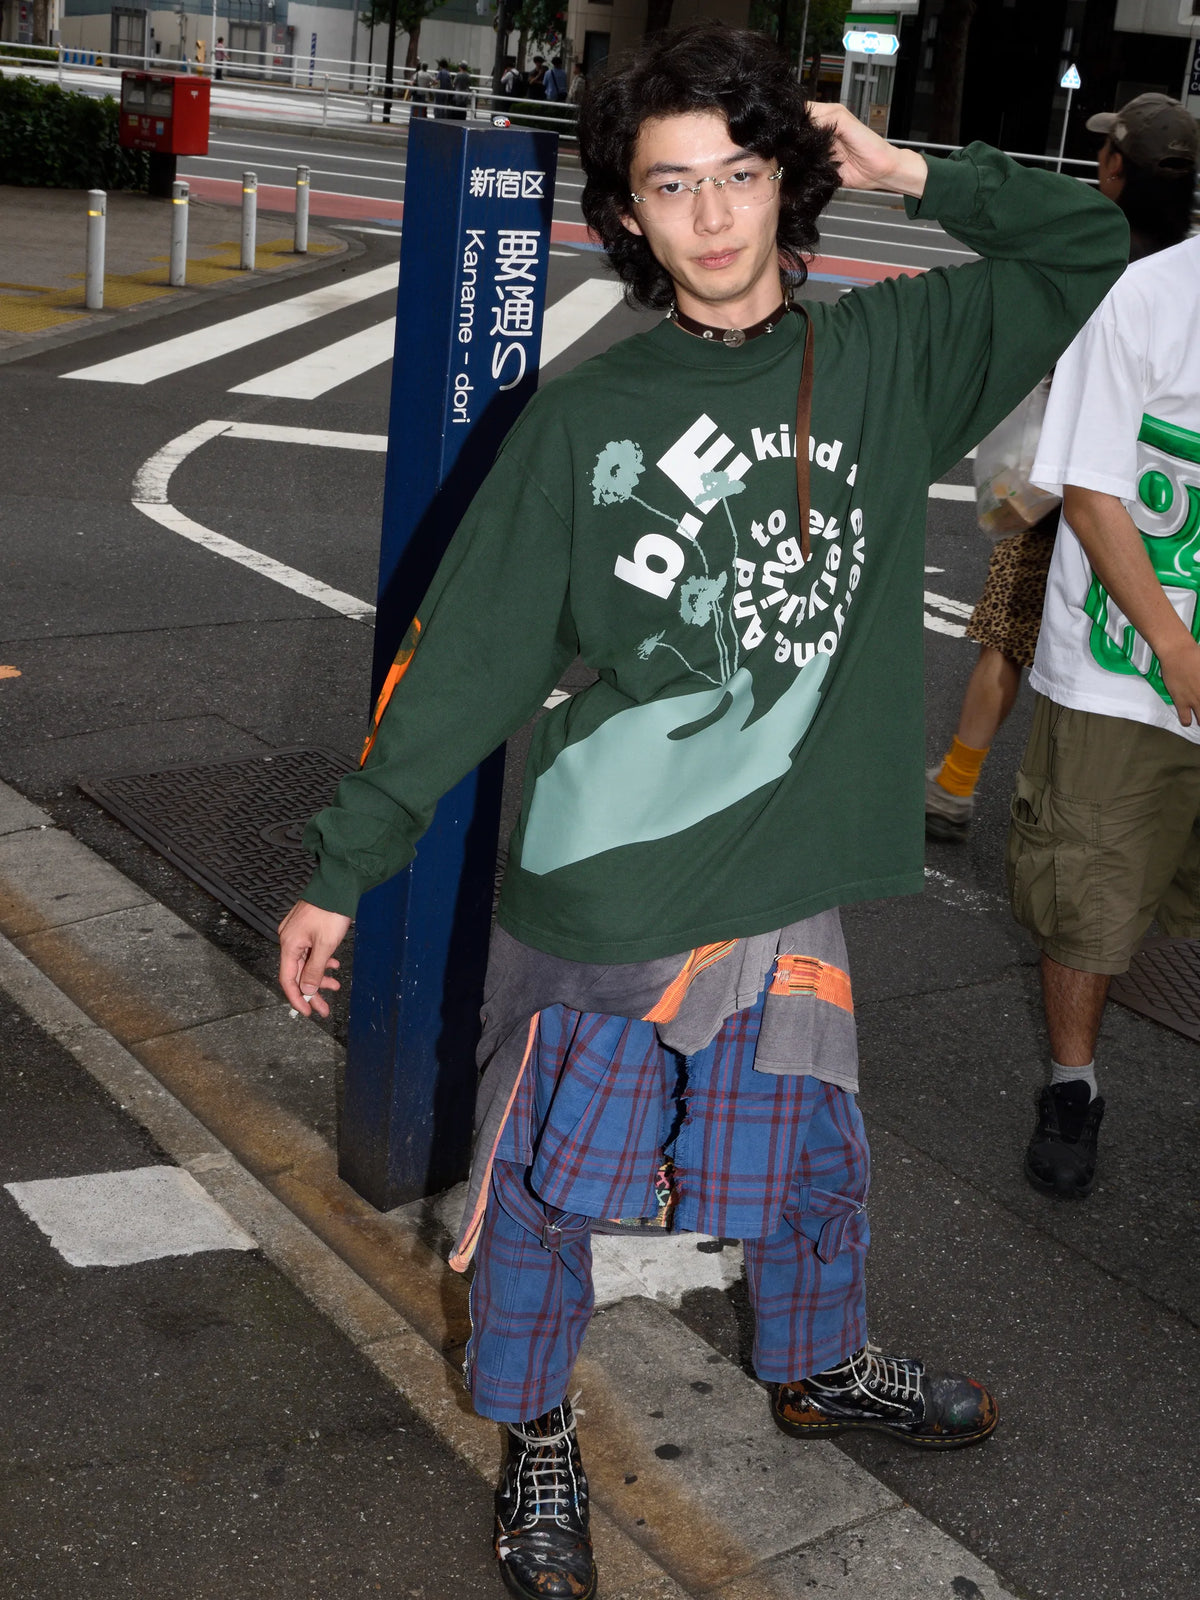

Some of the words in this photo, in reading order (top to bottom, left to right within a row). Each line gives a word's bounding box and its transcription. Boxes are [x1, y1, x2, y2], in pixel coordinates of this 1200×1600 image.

[469, 166, 546, 199] 新宿区
[457, 229, 486, 344] Kaname
[489, 229, 541, 392] 要通り
[452, 373, 474, 424] dori
[732, 557, 768, 651] And
[750, 509, 786, 548] to
